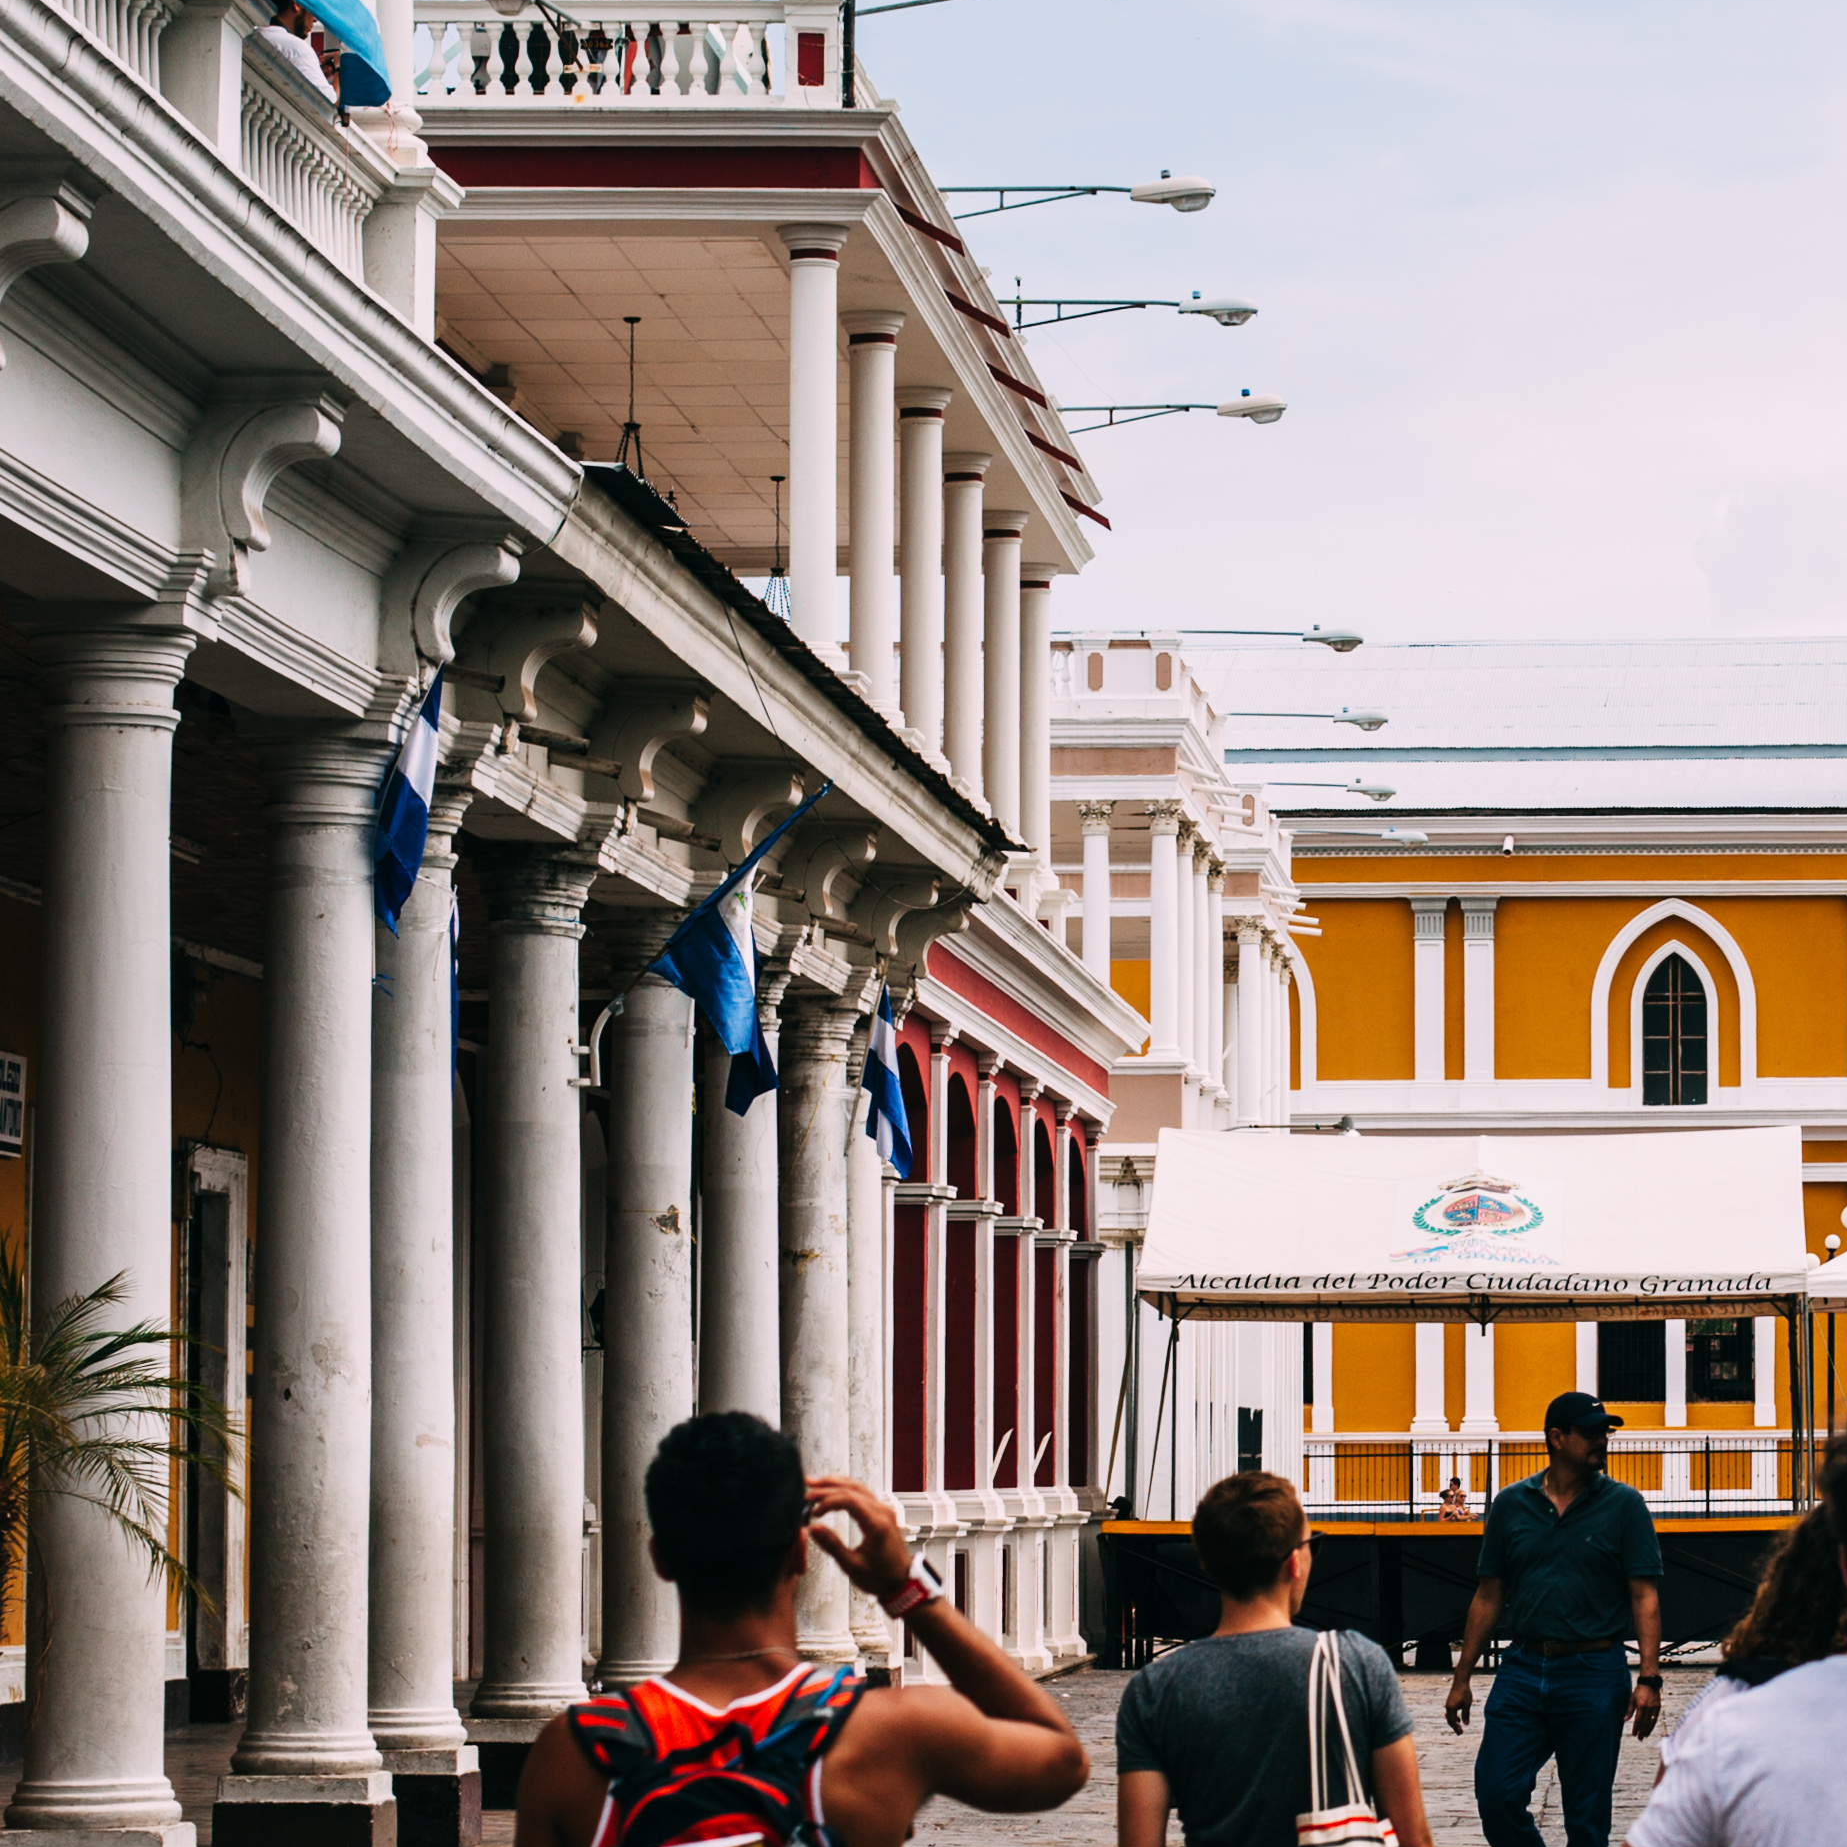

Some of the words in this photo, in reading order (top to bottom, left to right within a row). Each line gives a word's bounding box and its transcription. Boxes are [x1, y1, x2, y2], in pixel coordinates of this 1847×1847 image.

[1457, 1252, 1560, 1266] GRANADA
[1170, 1272, 1302, 1290] Alcaldia
[1312, 1272, 1357, 1290] del
[1367, 1271, 1457, 1290] Poder
[1465, 1271, 1629, 1293] Ciudadano
[1639, 1271, 1773, 1297] Granada
